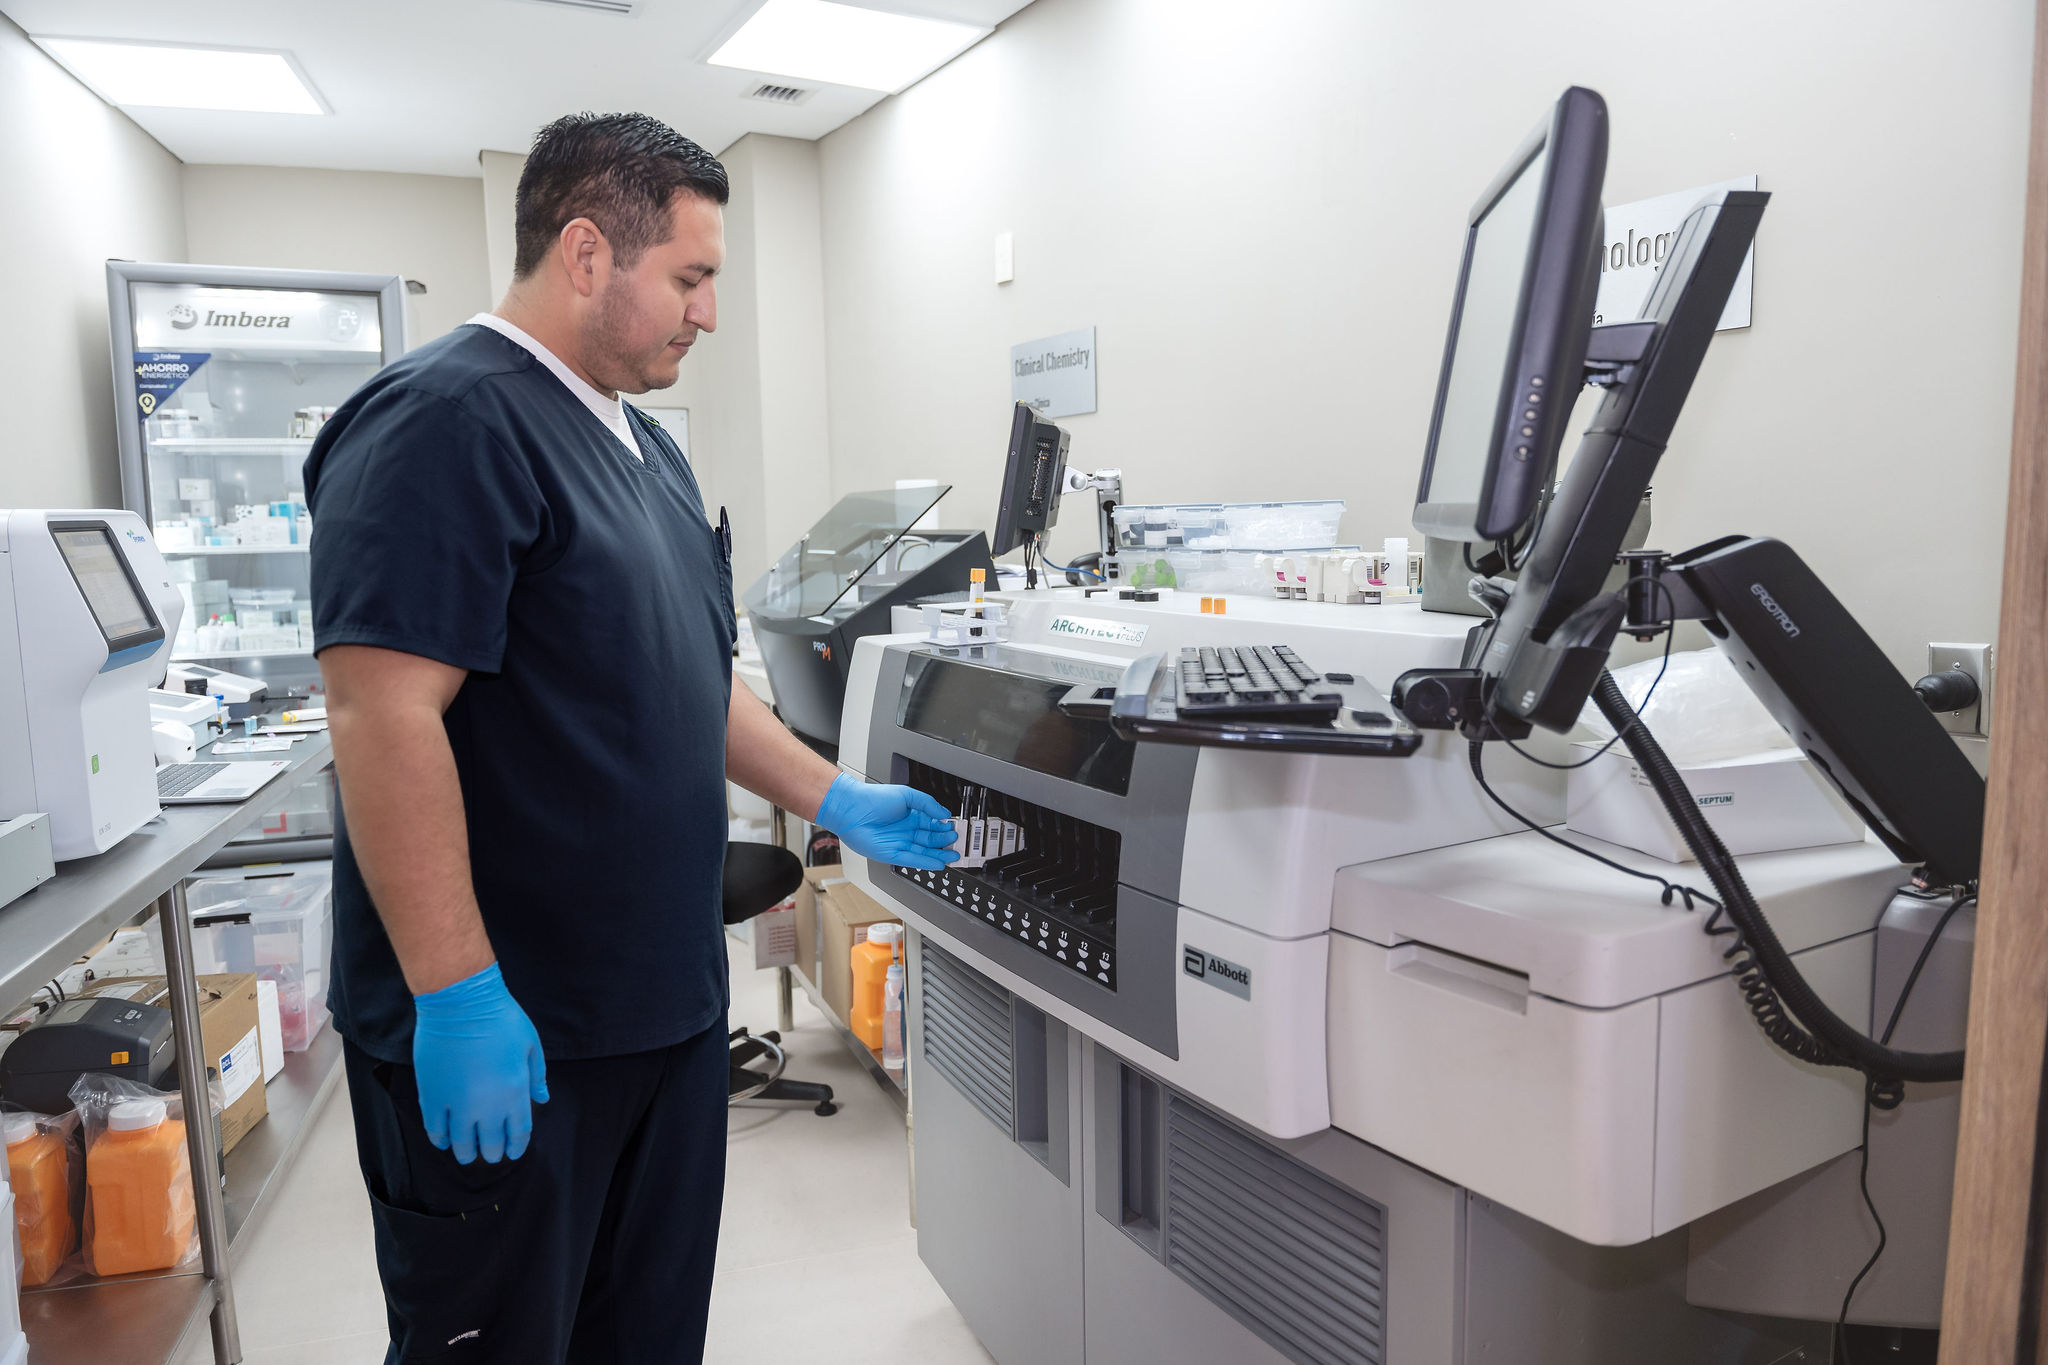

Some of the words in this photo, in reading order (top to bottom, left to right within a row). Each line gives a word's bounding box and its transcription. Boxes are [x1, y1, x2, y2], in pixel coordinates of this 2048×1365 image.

[204, 310, 290, 328] Imbera
[1014, 354, 1044, 377] Clinical
[1046, 347, 1090, 371] Chemistry
[1751, 583, 1800, 638] ERGOTRON
[1698, 795, 1733, 806] SEPTUM
[990, 894, 996, 903] 7
[1007, 903, 1012, 911] 8
[1024, 912, 1029, 920] 9
[1041, 921, 1049, 930] 10
[1061, 931, 1068, 940] 11
[1081, 941, 1088, 951] 12
[1102, 951, 1110, 962] 13
[1208, 958, 1248, 986] Abbott
